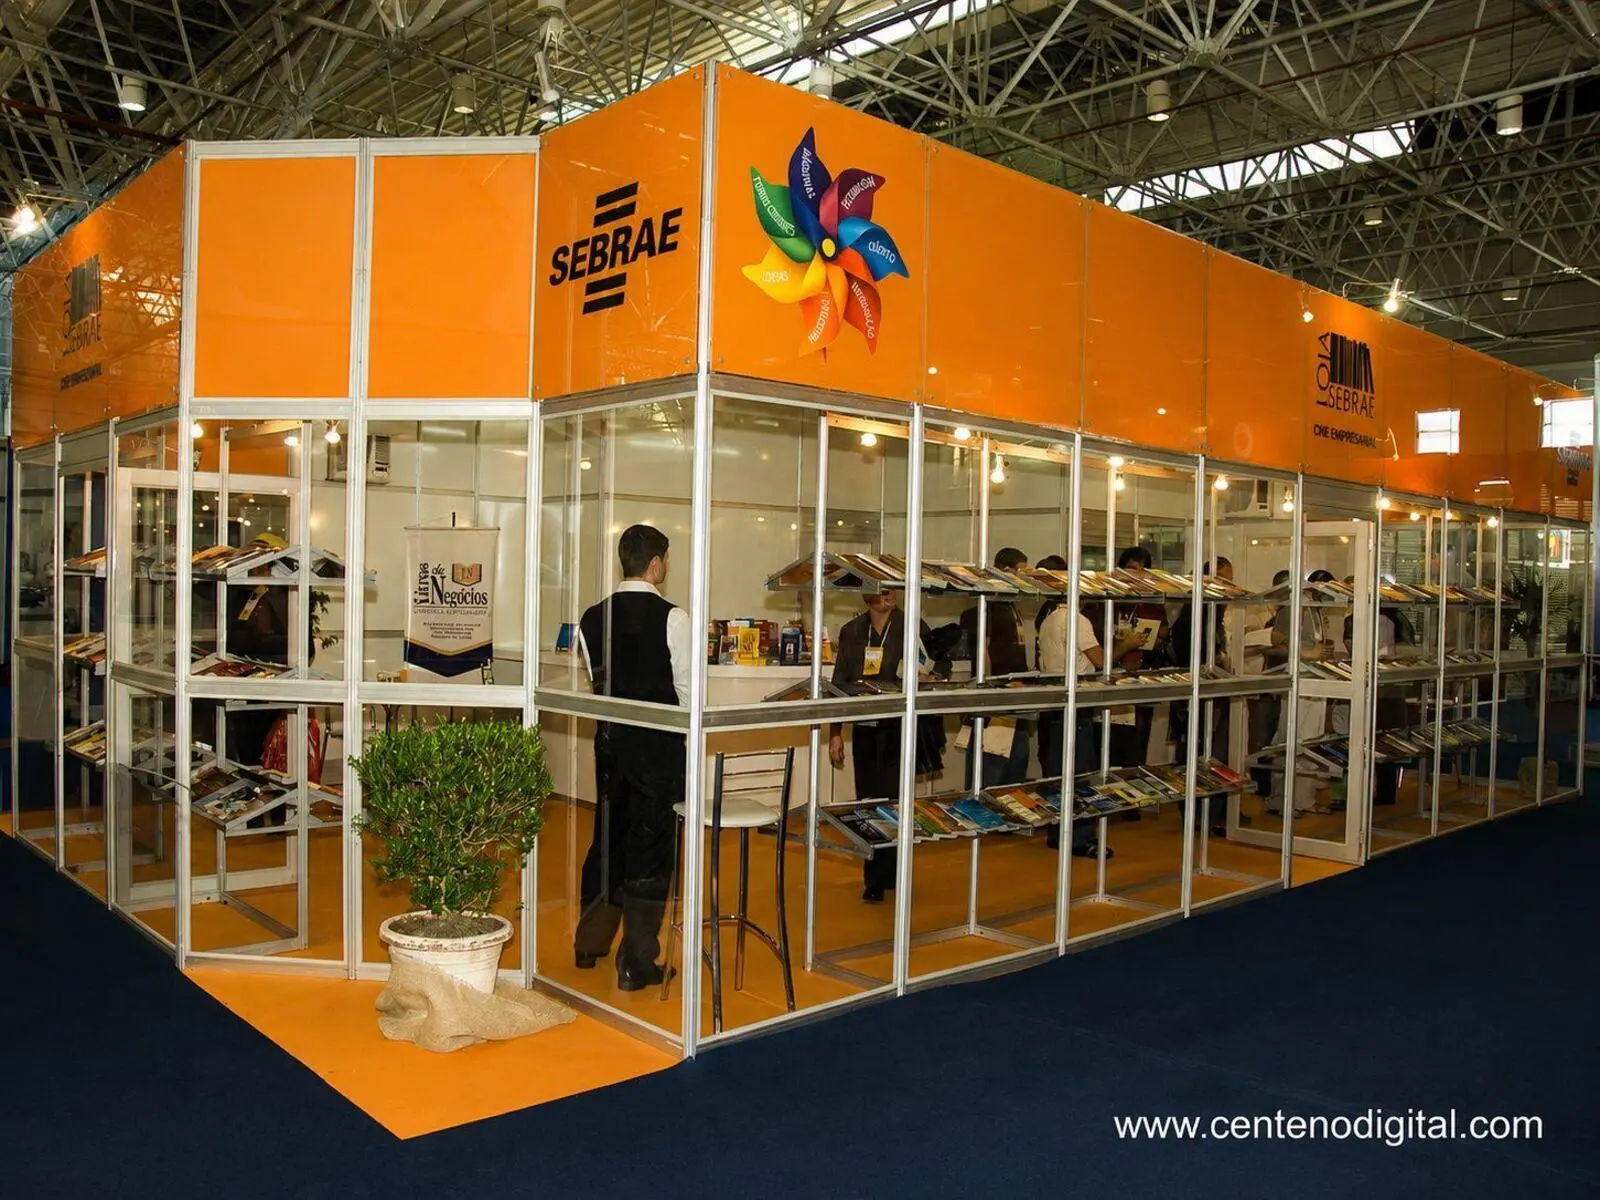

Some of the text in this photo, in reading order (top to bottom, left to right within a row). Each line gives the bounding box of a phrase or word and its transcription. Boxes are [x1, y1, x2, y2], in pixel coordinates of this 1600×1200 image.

[549, 207, 684, 287] SEBRAE
[1328, 383, 1376, 420] SEBRAE
[430, 575, 488, 609] Negócios
